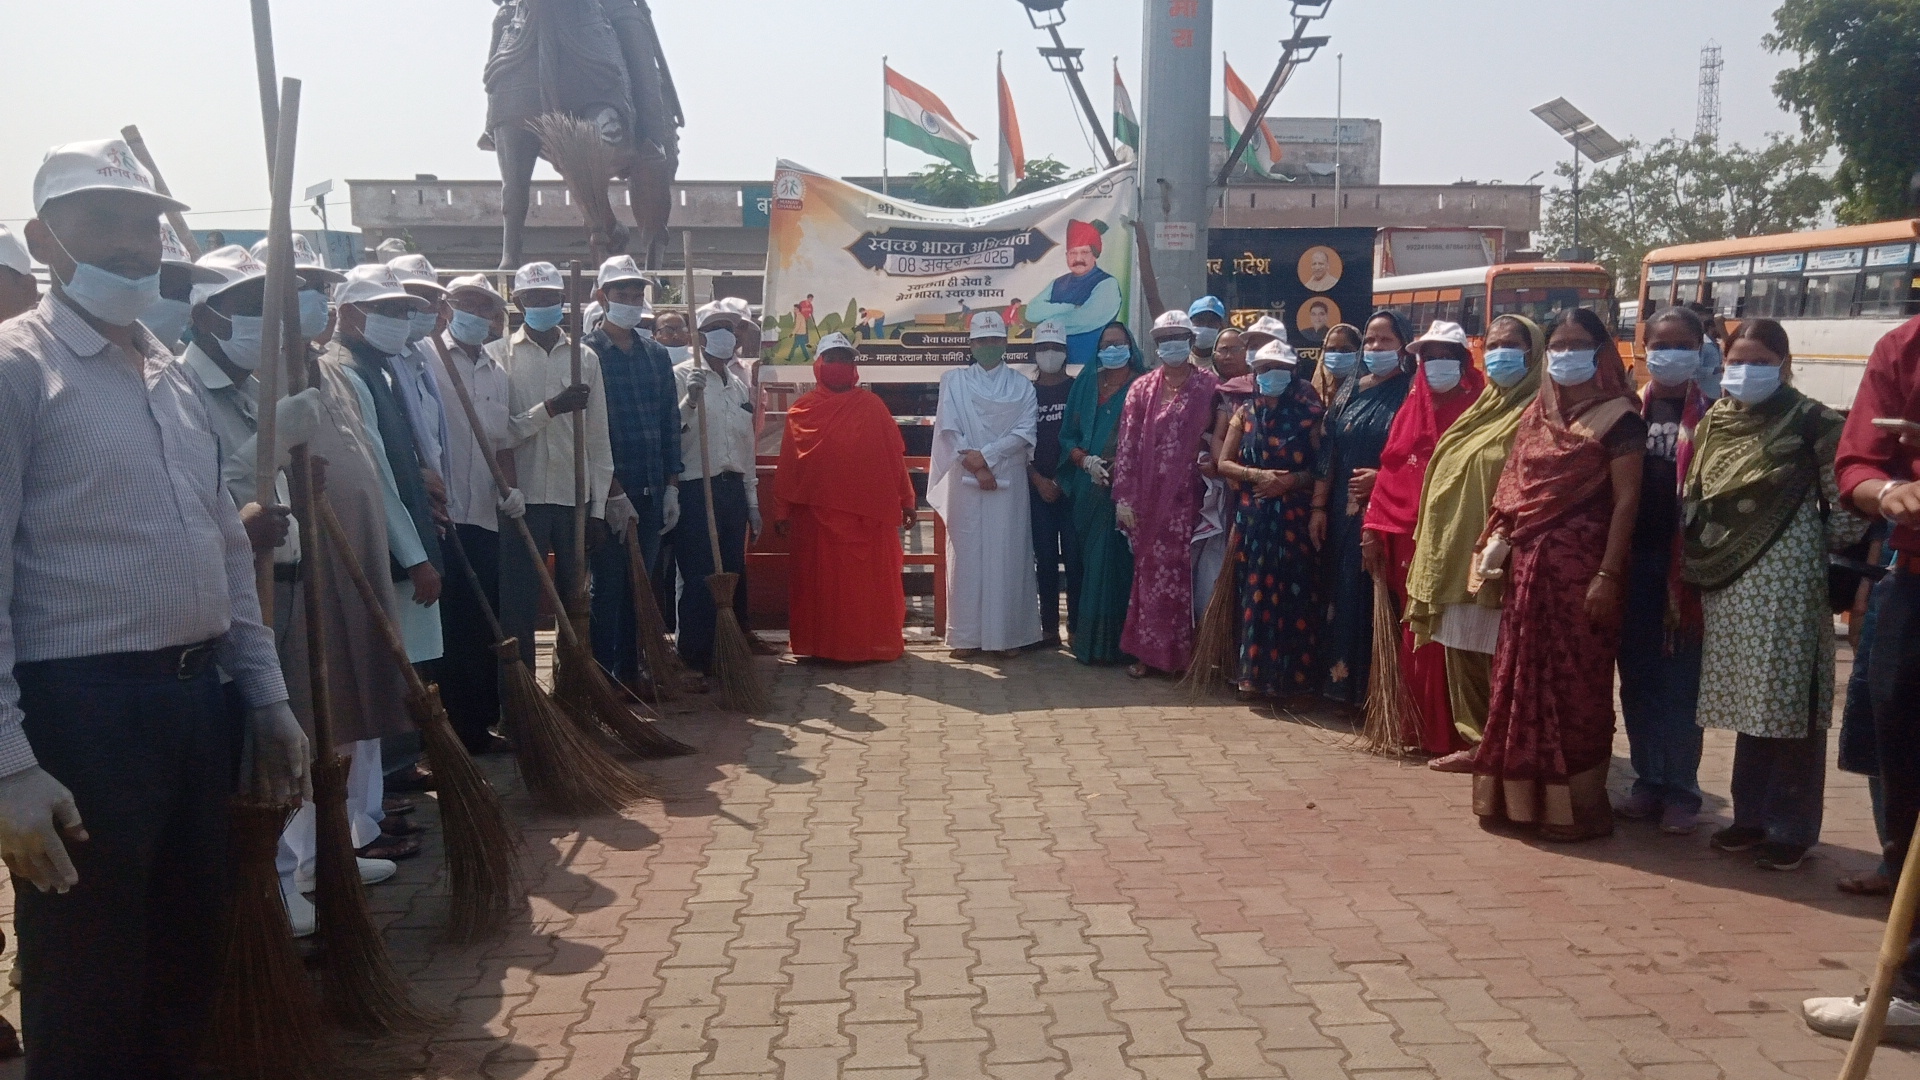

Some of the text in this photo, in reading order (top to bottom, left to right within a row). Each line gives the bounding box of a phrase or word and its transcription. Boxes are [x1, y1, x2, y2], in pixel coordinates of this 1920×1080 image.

[868, 233, 1031, 254] स्वच्छ भारत अभियान
[898, 257, 916, 272] 08
[973, 250, 1009, 264] 2026
[1233, 252, 1272, 276] प्रदेश
[947, 276, 958, 287] ही
[960, 277, 982, 287] सेवा
[984, 275, 992, 287] है
[914, 290, 943, 299] भारत,
[945, 289, 976, 299] स्वच्छ
[979, 289, 1005, 298] भारत
[921, 335, 939, 344] सेवा
[876, 354, 897, 362] मानव
[925, 352, 939, 362] सेवा
[942, 351, 964, 362] समिति
[1046, 411, 1062, 421] out
